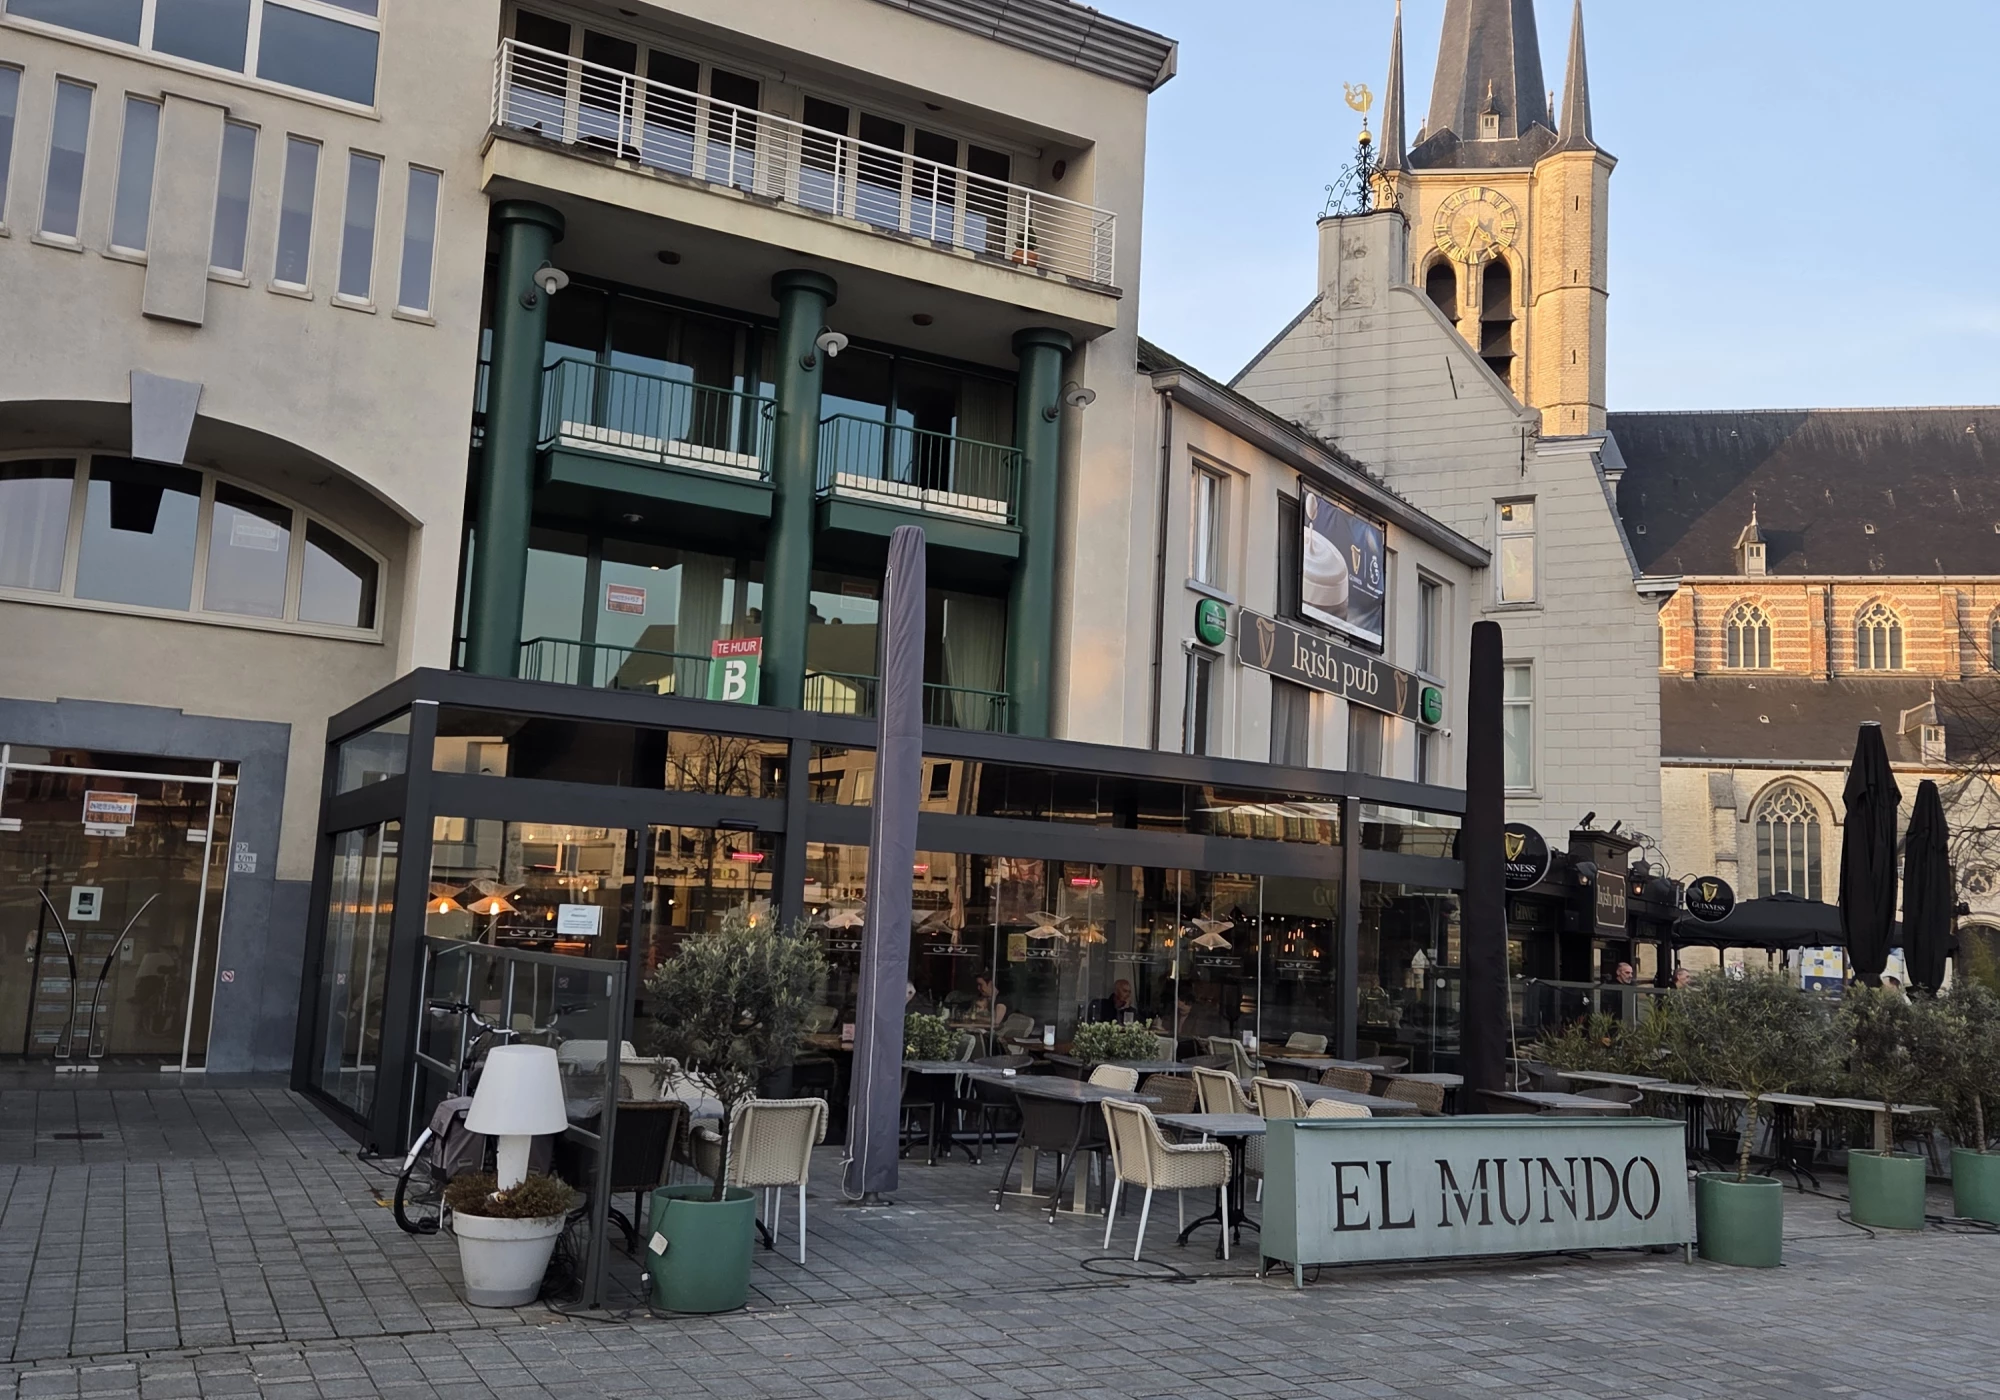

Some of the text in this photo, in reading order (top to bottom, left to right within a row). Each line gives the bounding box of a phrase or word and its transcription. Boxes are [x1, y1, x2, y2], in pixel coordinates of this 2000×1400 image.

[717, 641, 757, 654] TE HUUR
[722, 660, 747, 701] B
[1342, 659, 1379, 696] pub
[237, 843, 248, 853] 92
[238, 854, 254, 862] t/m
[1505, 863, 1537, 874] NNESS
[1613, 889, 1625, 914] pub
[1691, 901, 1726, 911] GUINNESS
[1331, 1155, 1661, 1233] EL MUNDO
